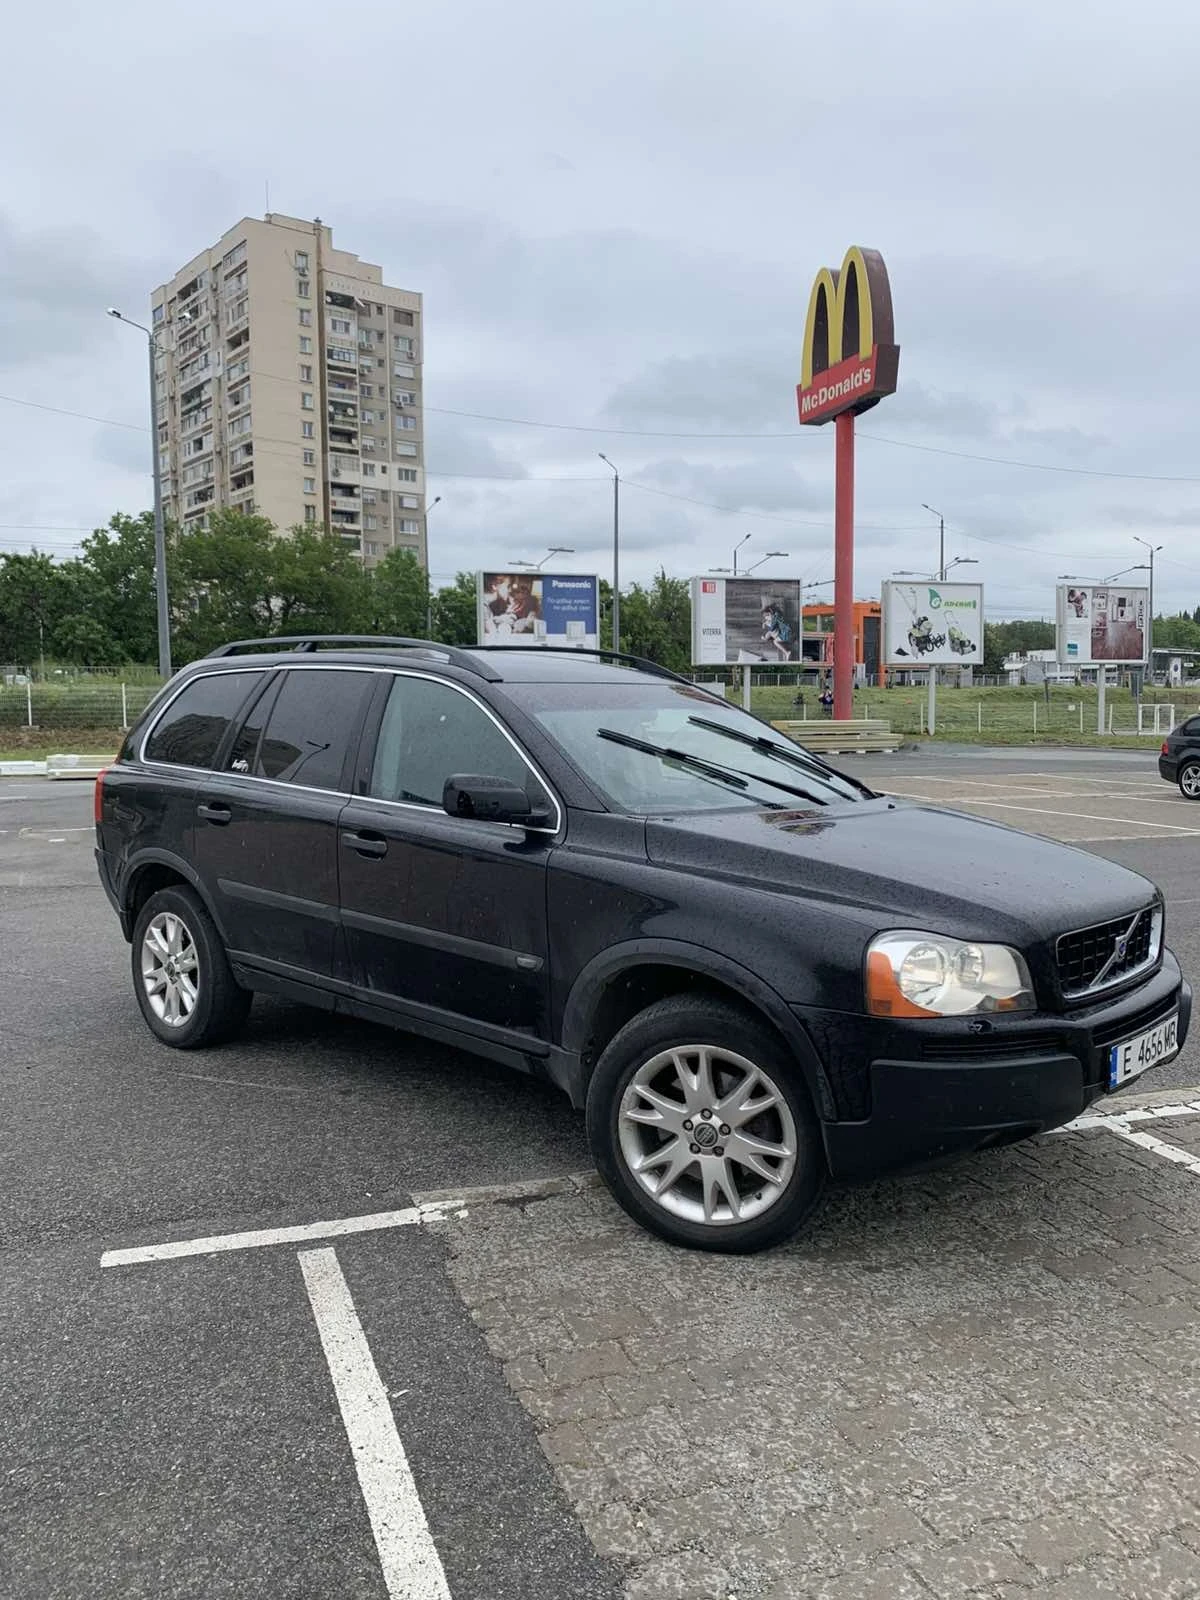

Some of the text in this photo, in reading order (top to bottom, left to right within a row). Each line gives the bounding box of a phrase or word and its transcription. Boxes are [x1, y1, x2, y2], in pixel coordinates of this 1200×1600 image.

[802, 366, 871, 415] McDonald's
[552, 579, 592, 589] Panasonic
[1123, 1045, 1132, 1076] E
[1138, 1028, 1162, 1066] 4656
